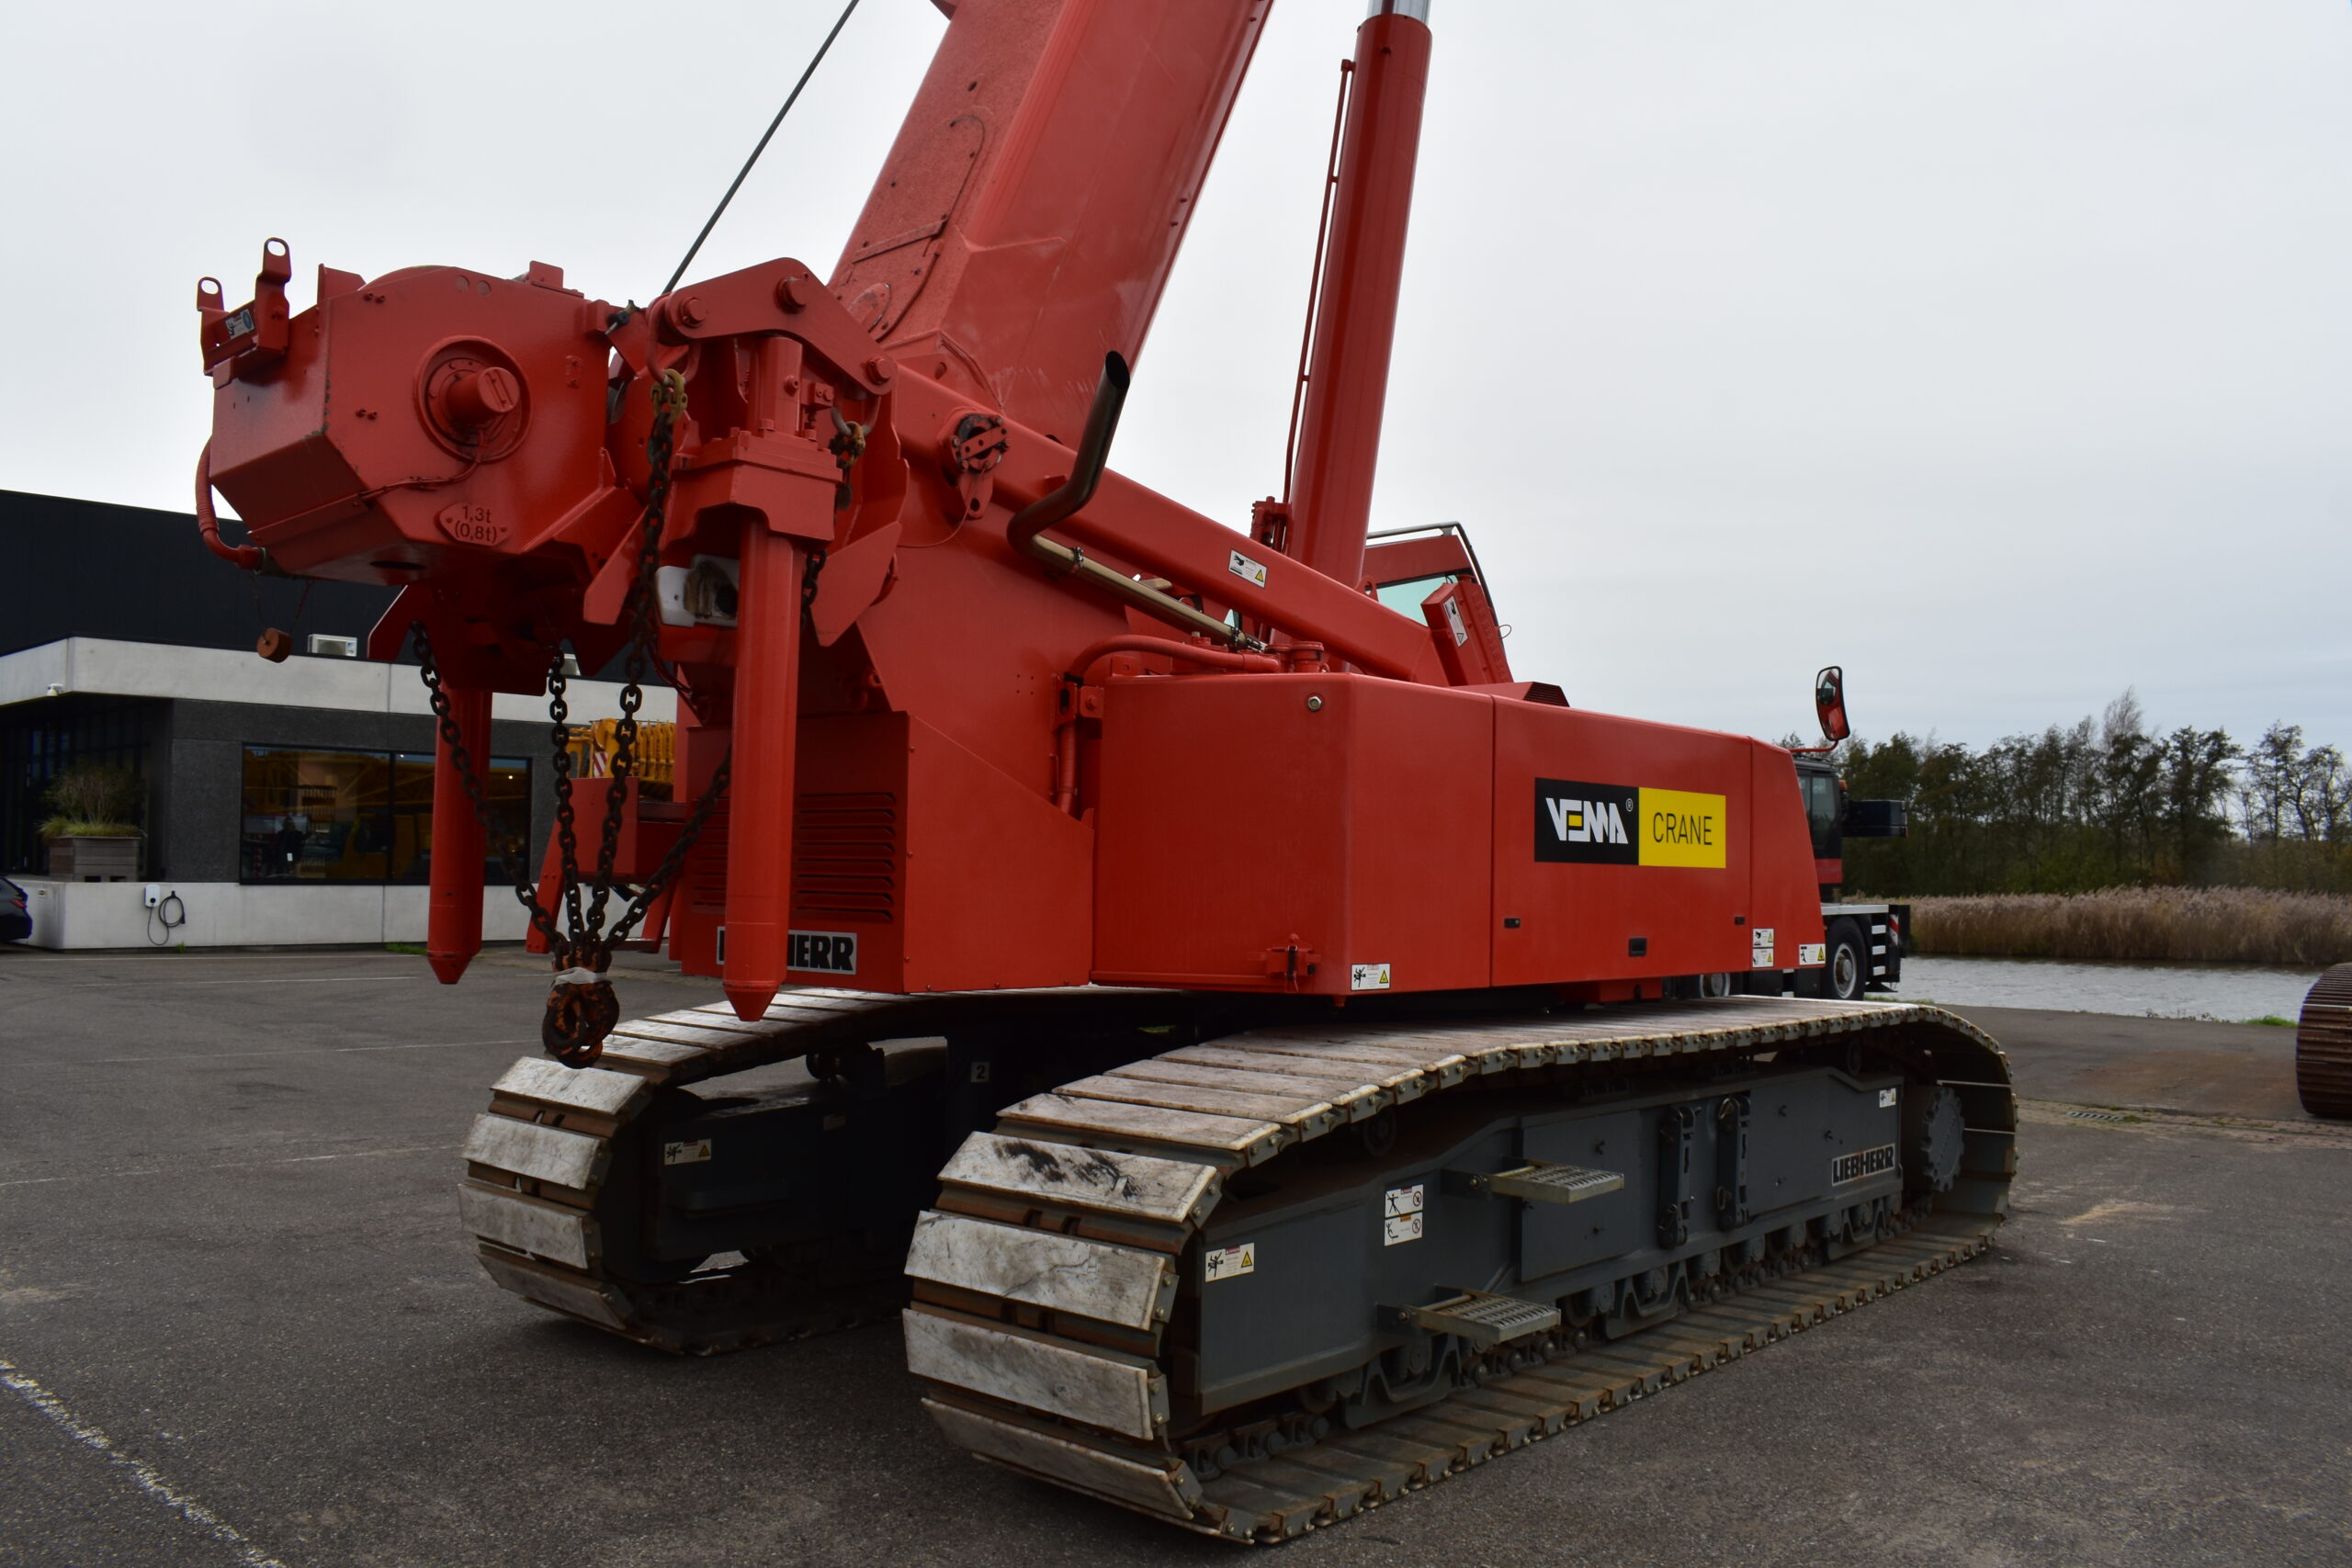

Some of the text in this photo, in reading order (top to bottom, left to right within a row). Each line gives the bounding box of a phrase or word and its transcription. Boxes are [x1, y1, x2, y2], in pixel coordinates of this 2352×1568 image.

[1653, 812, 1713, 845] CRANE
[976, 1065, 986, 1080] 2
[1833, 1145, 1894, 1184] LIEBHERR
